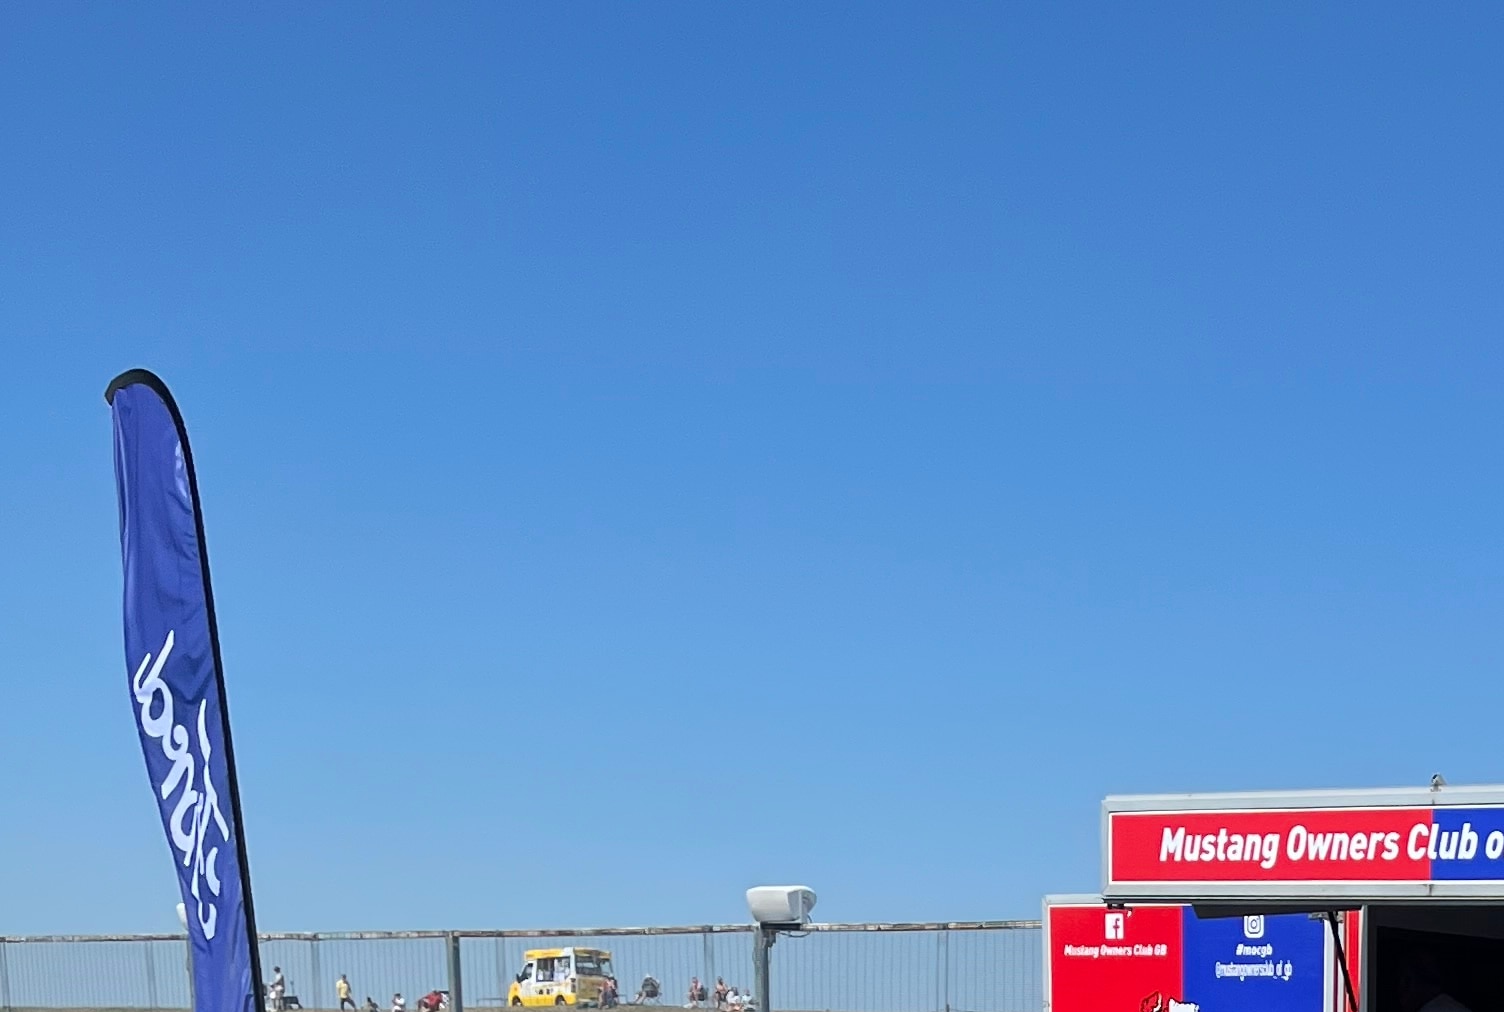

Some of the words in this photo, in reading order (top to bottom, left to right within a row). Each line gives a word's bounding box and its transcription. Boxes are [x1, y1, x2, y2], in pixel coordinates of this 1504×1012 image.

[1160, 826, 1280, 869] Mustang
[1287, 825, 1400, 861] Owners
[1407, 822, 1478, 860] Club
[1064, 944, 1100, 958] Mustang
[1100, 944, 1132, 957] Owners
[1134, 944, 1153, 956] Club
[1154, 944, 1168, 957] GB
[1236, 944, 1273, 958] #mocgb
